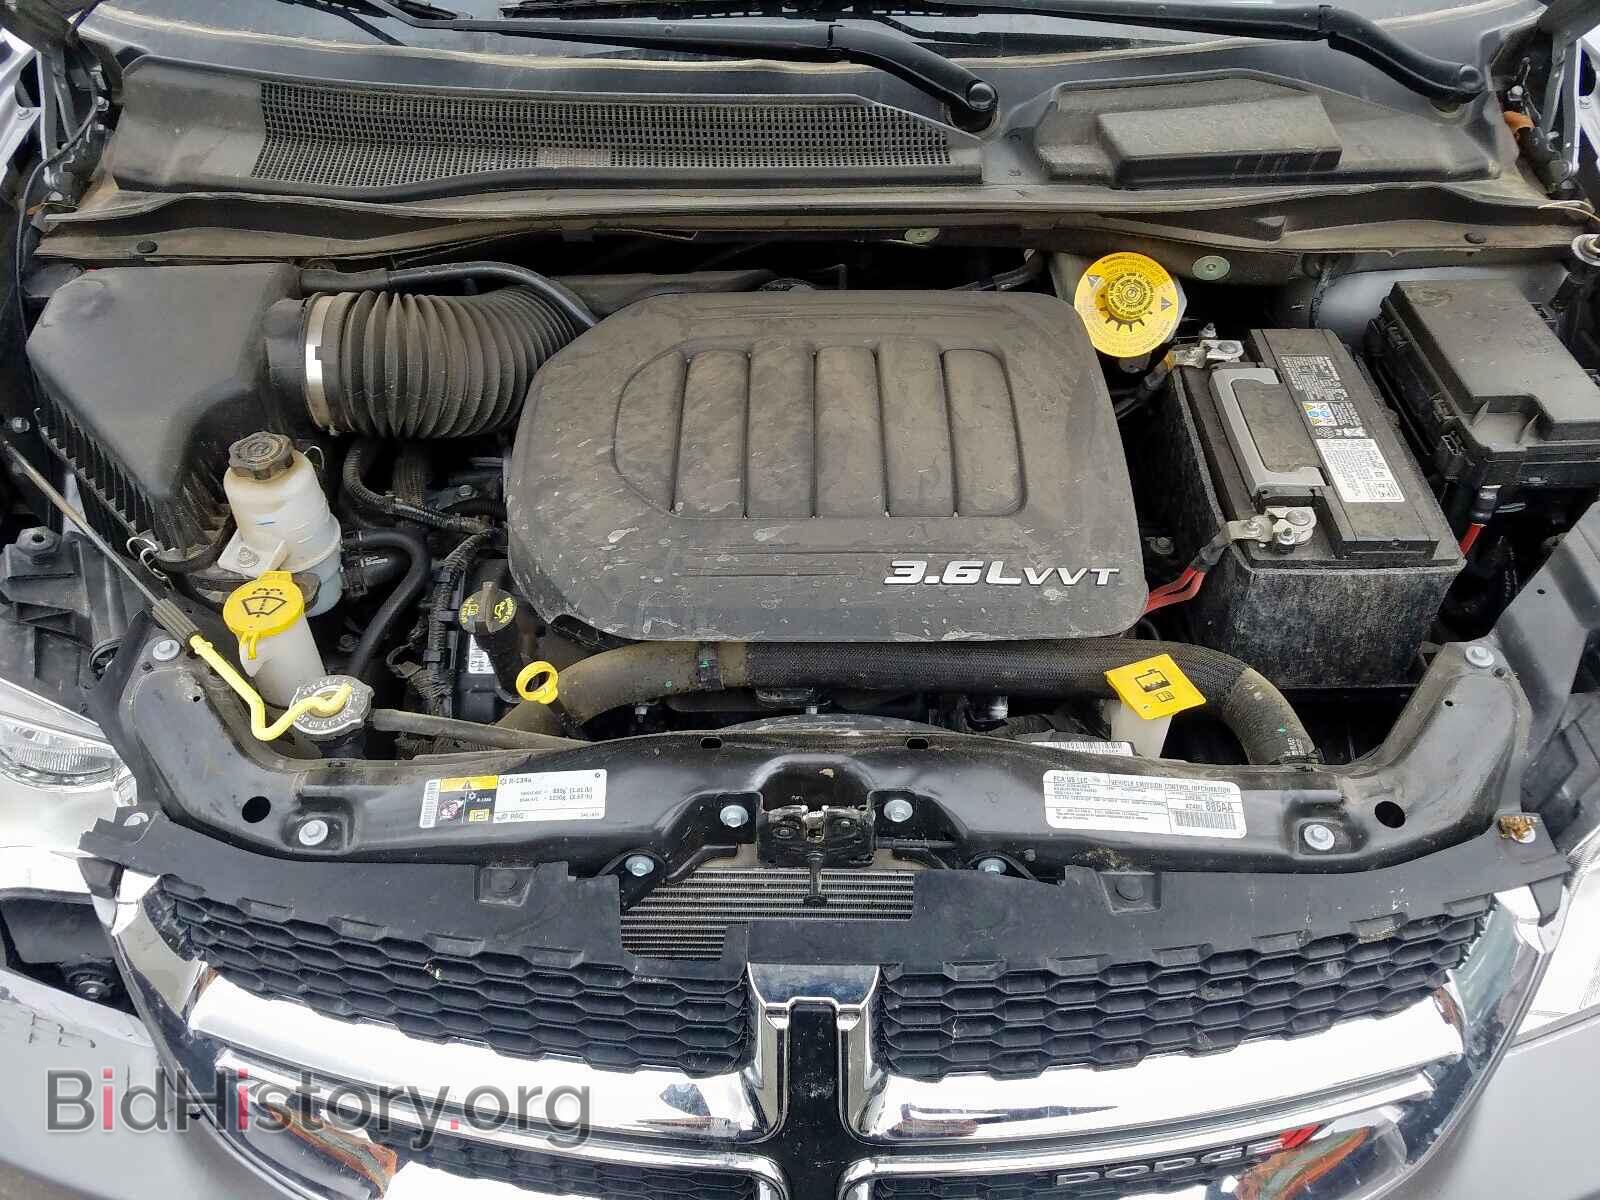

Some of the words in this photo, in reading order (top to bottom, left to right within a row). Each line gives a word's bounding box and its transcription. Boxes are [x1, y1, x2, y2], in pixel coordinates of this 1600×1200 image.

[1164, 783, 1190, 791] CONTROL
[1191, 785, 1231, 793] INFORMATION
[1056, 1138, 1286, 1186] DODGE
